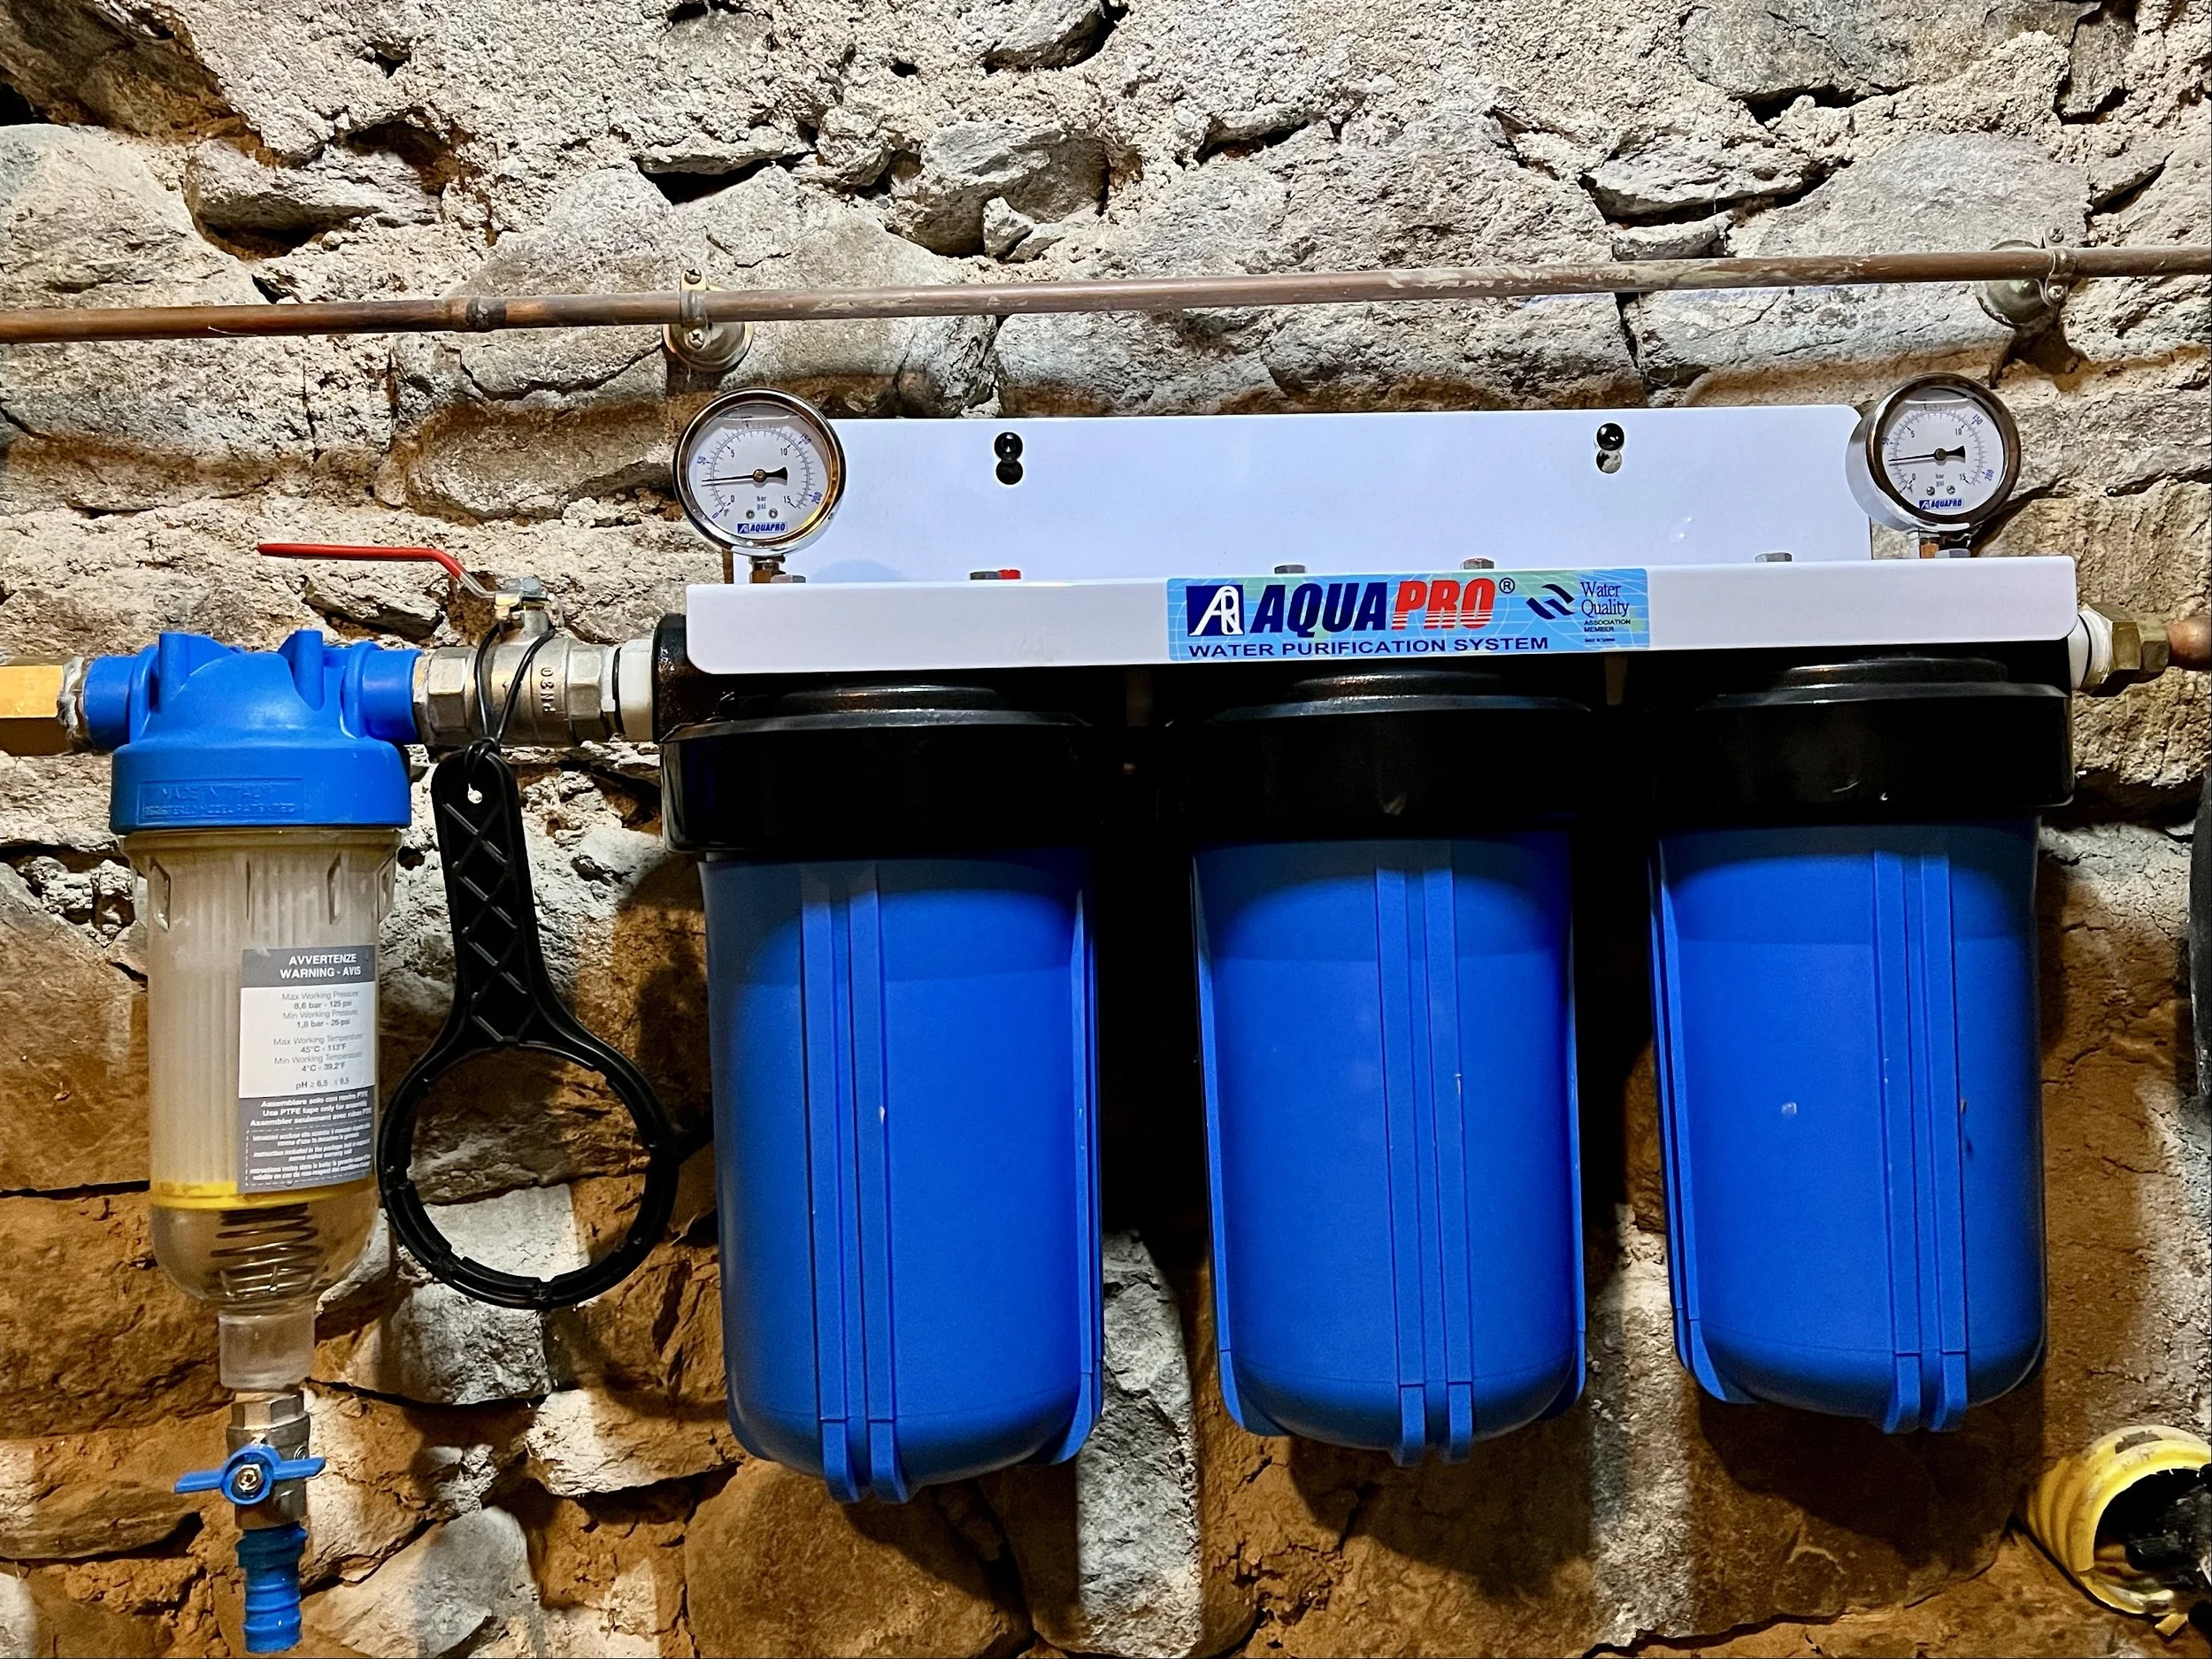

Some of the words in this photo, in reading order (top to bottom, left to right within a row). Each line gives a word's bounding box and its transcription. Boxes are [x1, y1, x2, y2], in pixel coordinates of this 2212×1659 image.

[1971, 414, 1983, 426] 150
[730, 449, 735, 457] 5
[697, 456, 707, 465] 50
[1959, 472, 1967, 481] 15
[730, 495, 735, 503] 0
[811, 491, 823, 504] 200
[1931, 499, 1962, 508] AQUAPRO
[750, 523, 786, 532] AQUAPRO
[1579, 581, 1621, 597] Water
[1581, 599, 1629, 618] Quality
[1188, 643, 1275, 657] WATER
[1283, 639, 1446, 656] PURIFICATION
[1454, 636, 1548, 651] SYSTEM
[288, 953, 357, 965] AVVERTENZE
[280, 967, 335, 979] WARNING
[342, 966, 361, 976] AVIS
[302, 991, 332, 1000] Working
[300, 1010, 331, 1019] Working
[294, 1036, 325, 1045] Working
[292, 1055, 323, 1064] Working
[296, 1081, 308, 1090] pH
[280, 1107, 301, 1116] PTFE
[250, 1118, 293, 1126] Assembler
